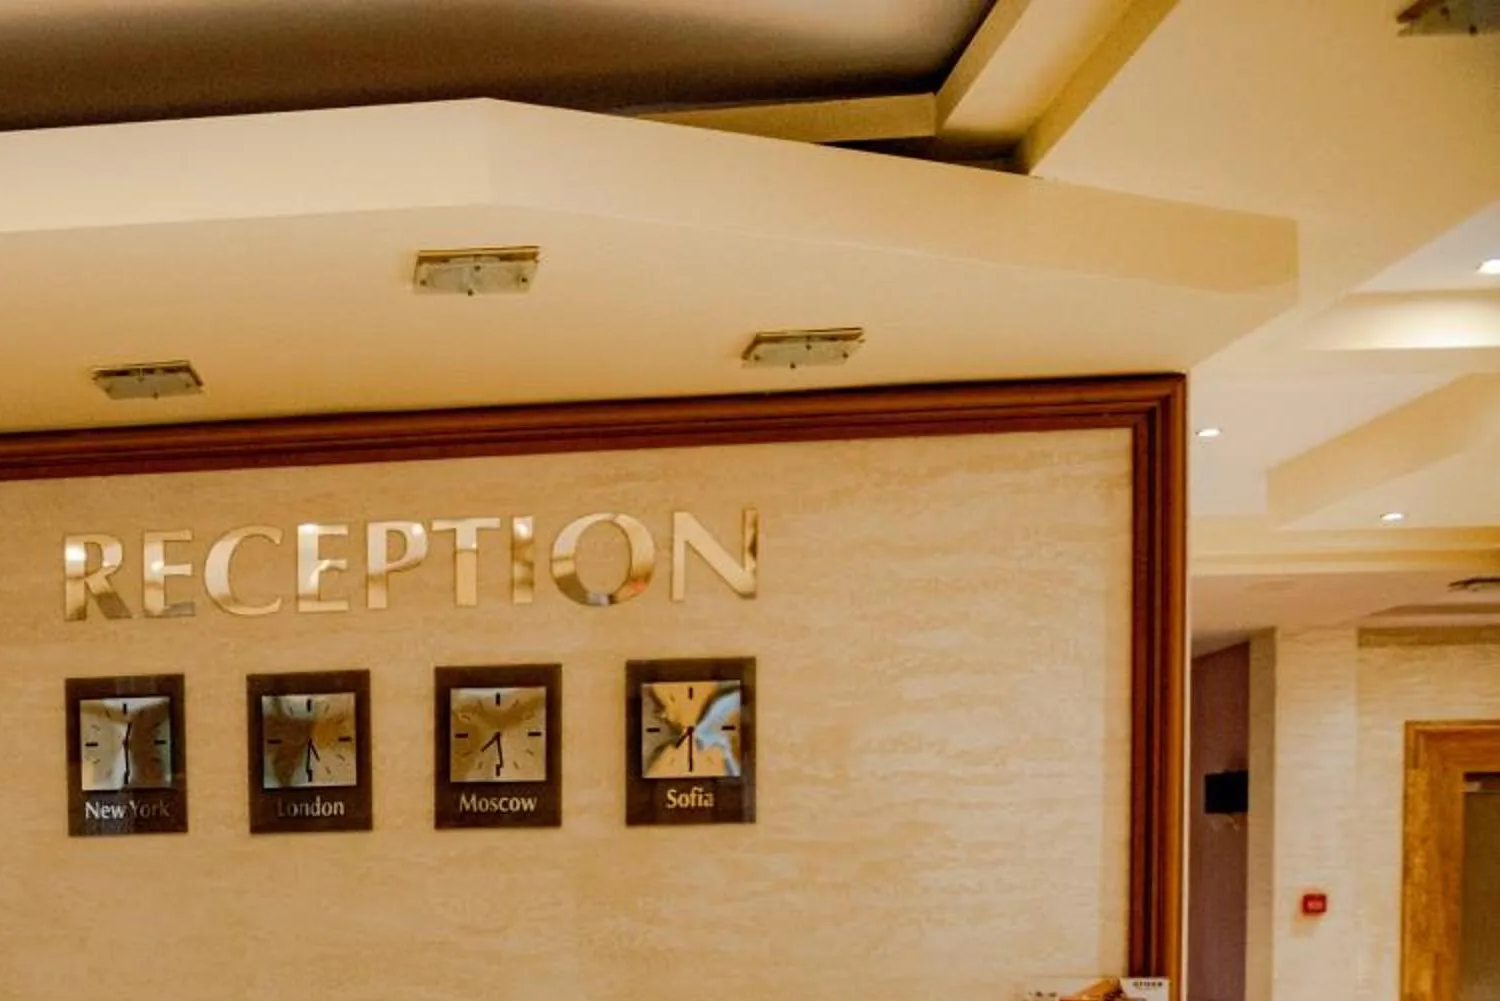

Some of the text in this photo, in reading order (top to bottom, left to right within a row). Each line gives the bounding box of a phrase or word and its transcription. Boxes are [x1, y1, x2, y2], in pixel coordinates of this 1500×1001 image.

[63, 507, 759, 620] RECEPTION
[277, 795, 346, 817] London
[458, 792, 538, 813] Moscow
[666, 785, 715, 809] Sofia
[84, 799, 171, 820] New York
